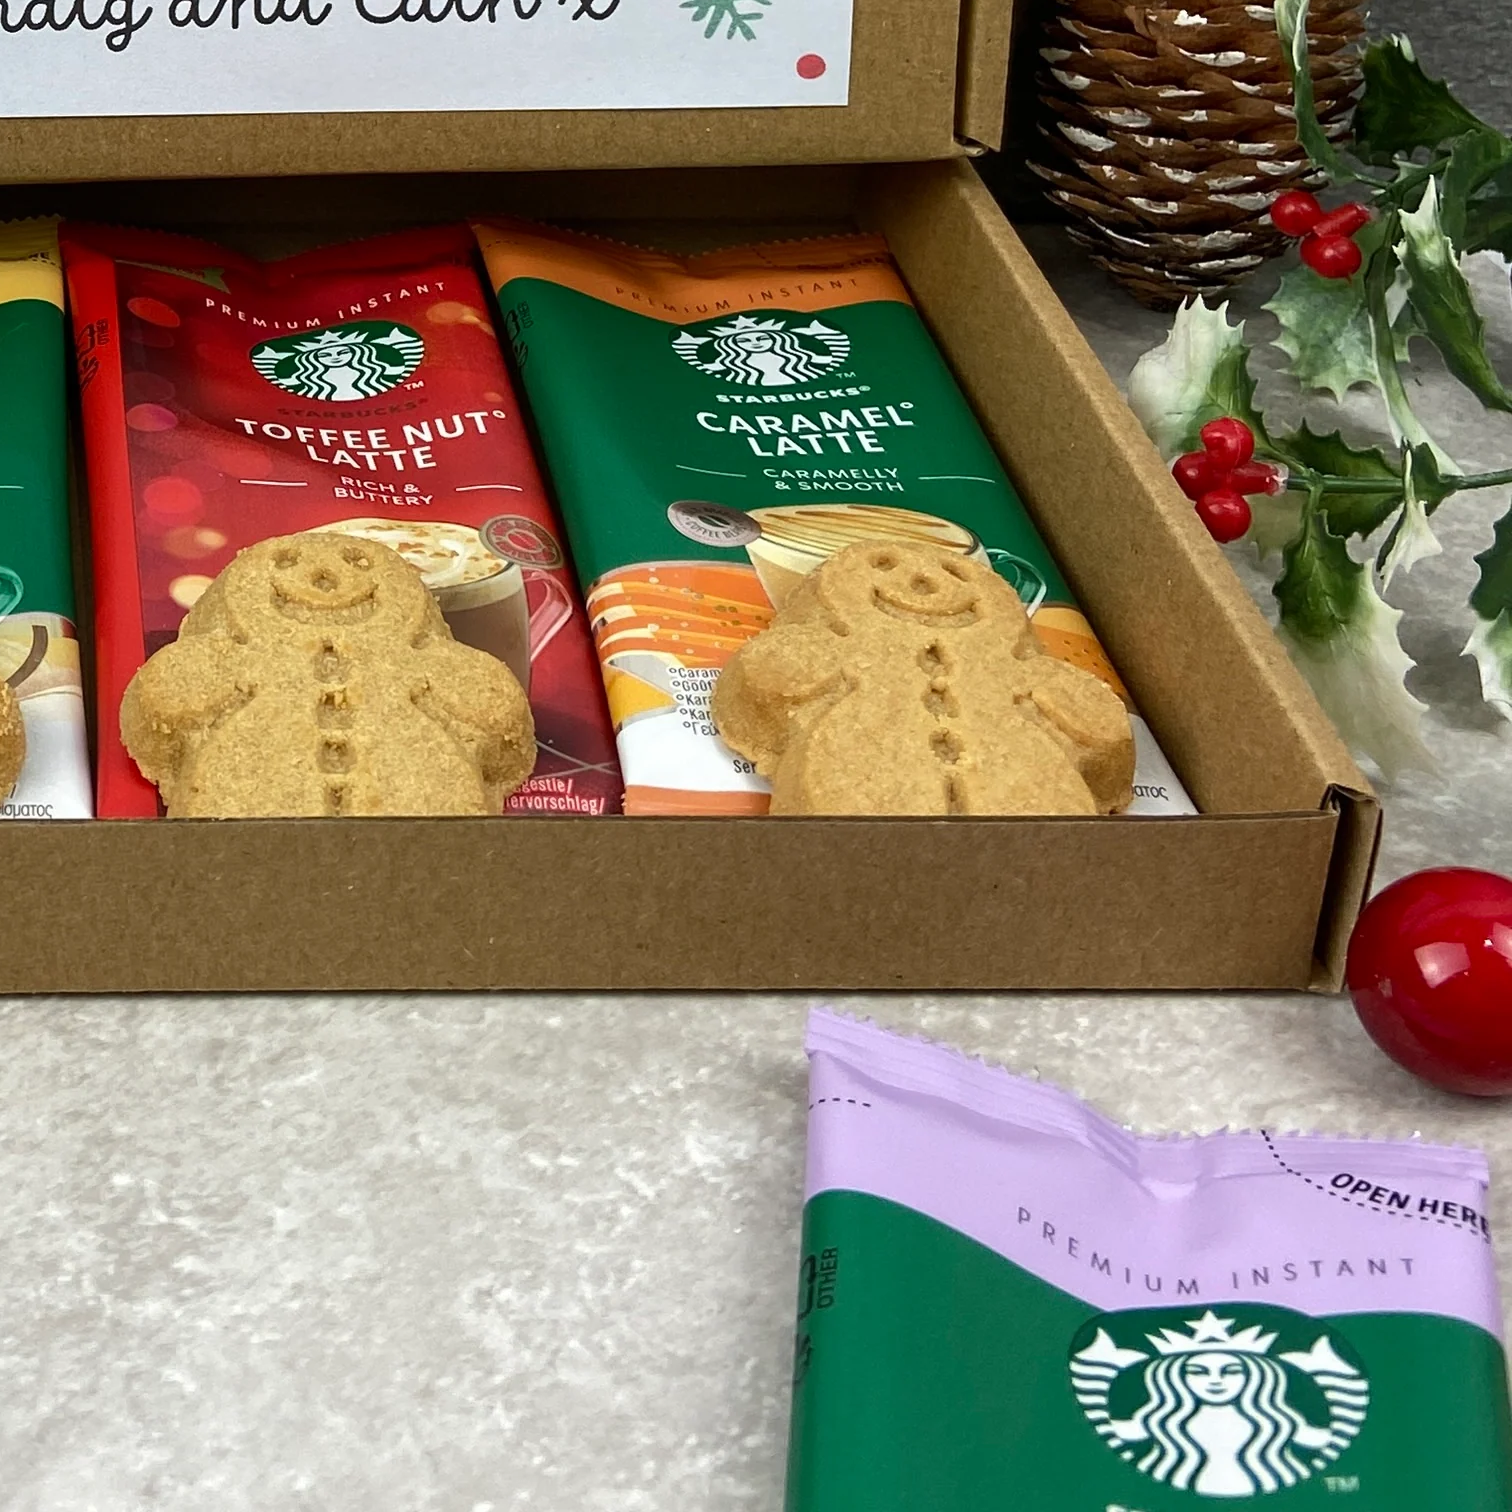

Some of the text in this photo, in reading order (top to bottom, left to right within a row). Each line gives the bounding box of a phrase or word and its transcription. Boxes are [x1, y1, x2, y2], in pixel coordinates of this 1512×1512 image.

[205, 281, 447, 329] PREMIUM INSTANT
[615, 277, 858, 315] PREMIUM INSTANT
[404, 380, 425, 392] TM
[235, 417, 391, 452] TOFFEE
[746, 430, 886, 459] LATTE
[306, 444, 438, 472] LATTE
[341, 475, 420, 494] RICH &
[762, 465, 899, 483] CARAMELLY
[774, 479, 905, 494] & SMOOTH
[334, 486, 434, 507] BUTTERY
[733, 759, 757, 774] Ser
[1330, 1173, 1410, 1210] OPEN
[1017, 1206, 1417, 1296] PREMIUM INSTANT
[817, 1246, 838, 1310] OTHER
[1324, 1476, 1359, 1492] TM
